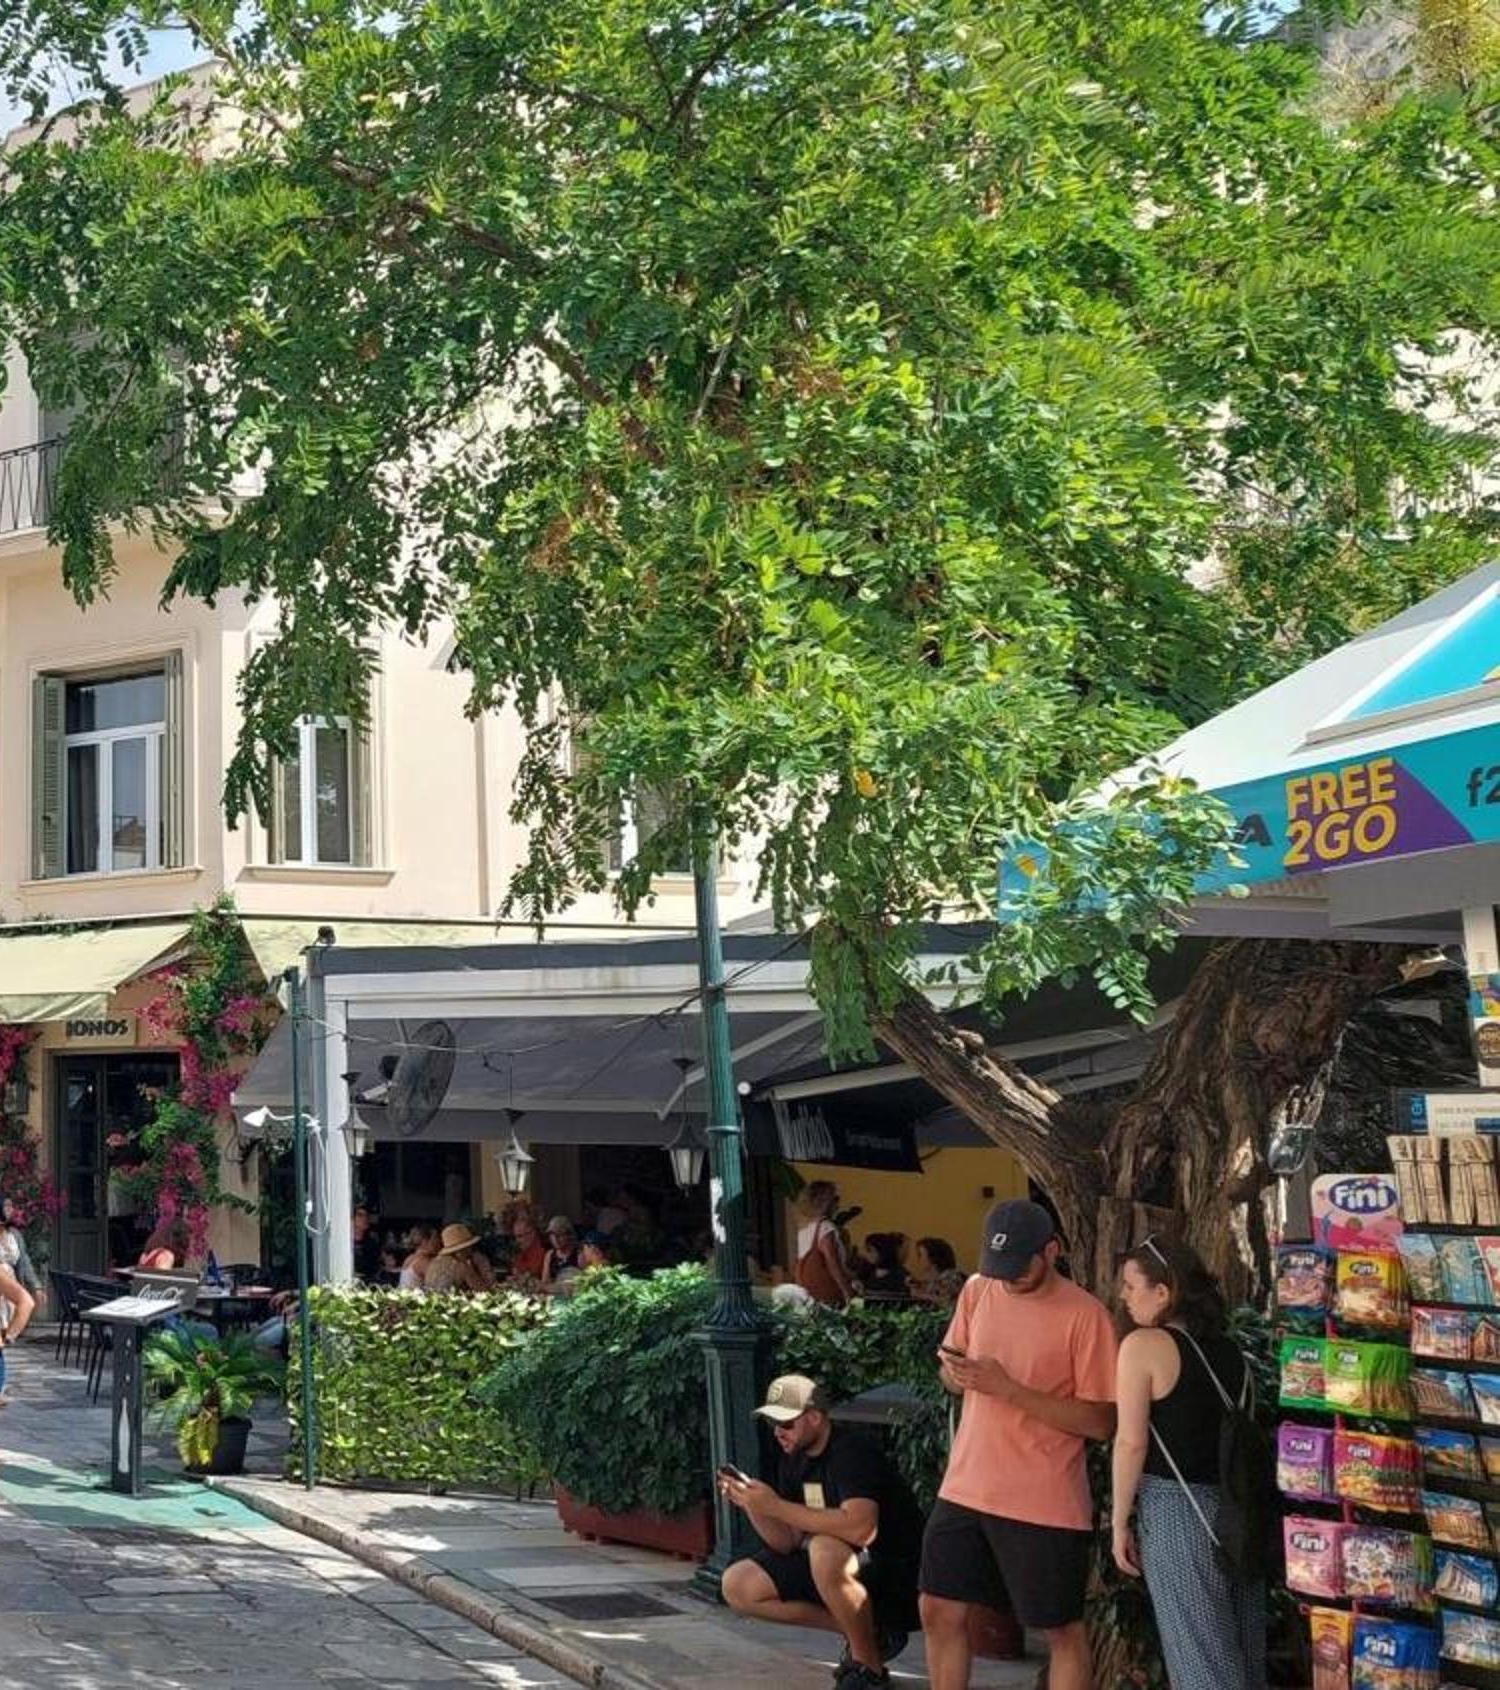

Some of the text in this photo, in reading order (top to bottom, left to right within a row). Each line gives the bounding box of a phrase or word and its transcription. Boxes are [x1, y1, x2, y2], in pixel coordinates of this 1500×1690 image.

[1284, 756, 1397, 820] FREE
[1283, 803, 1397, 866] 2GO
[67, 1019, 129, 1037] IONOS
